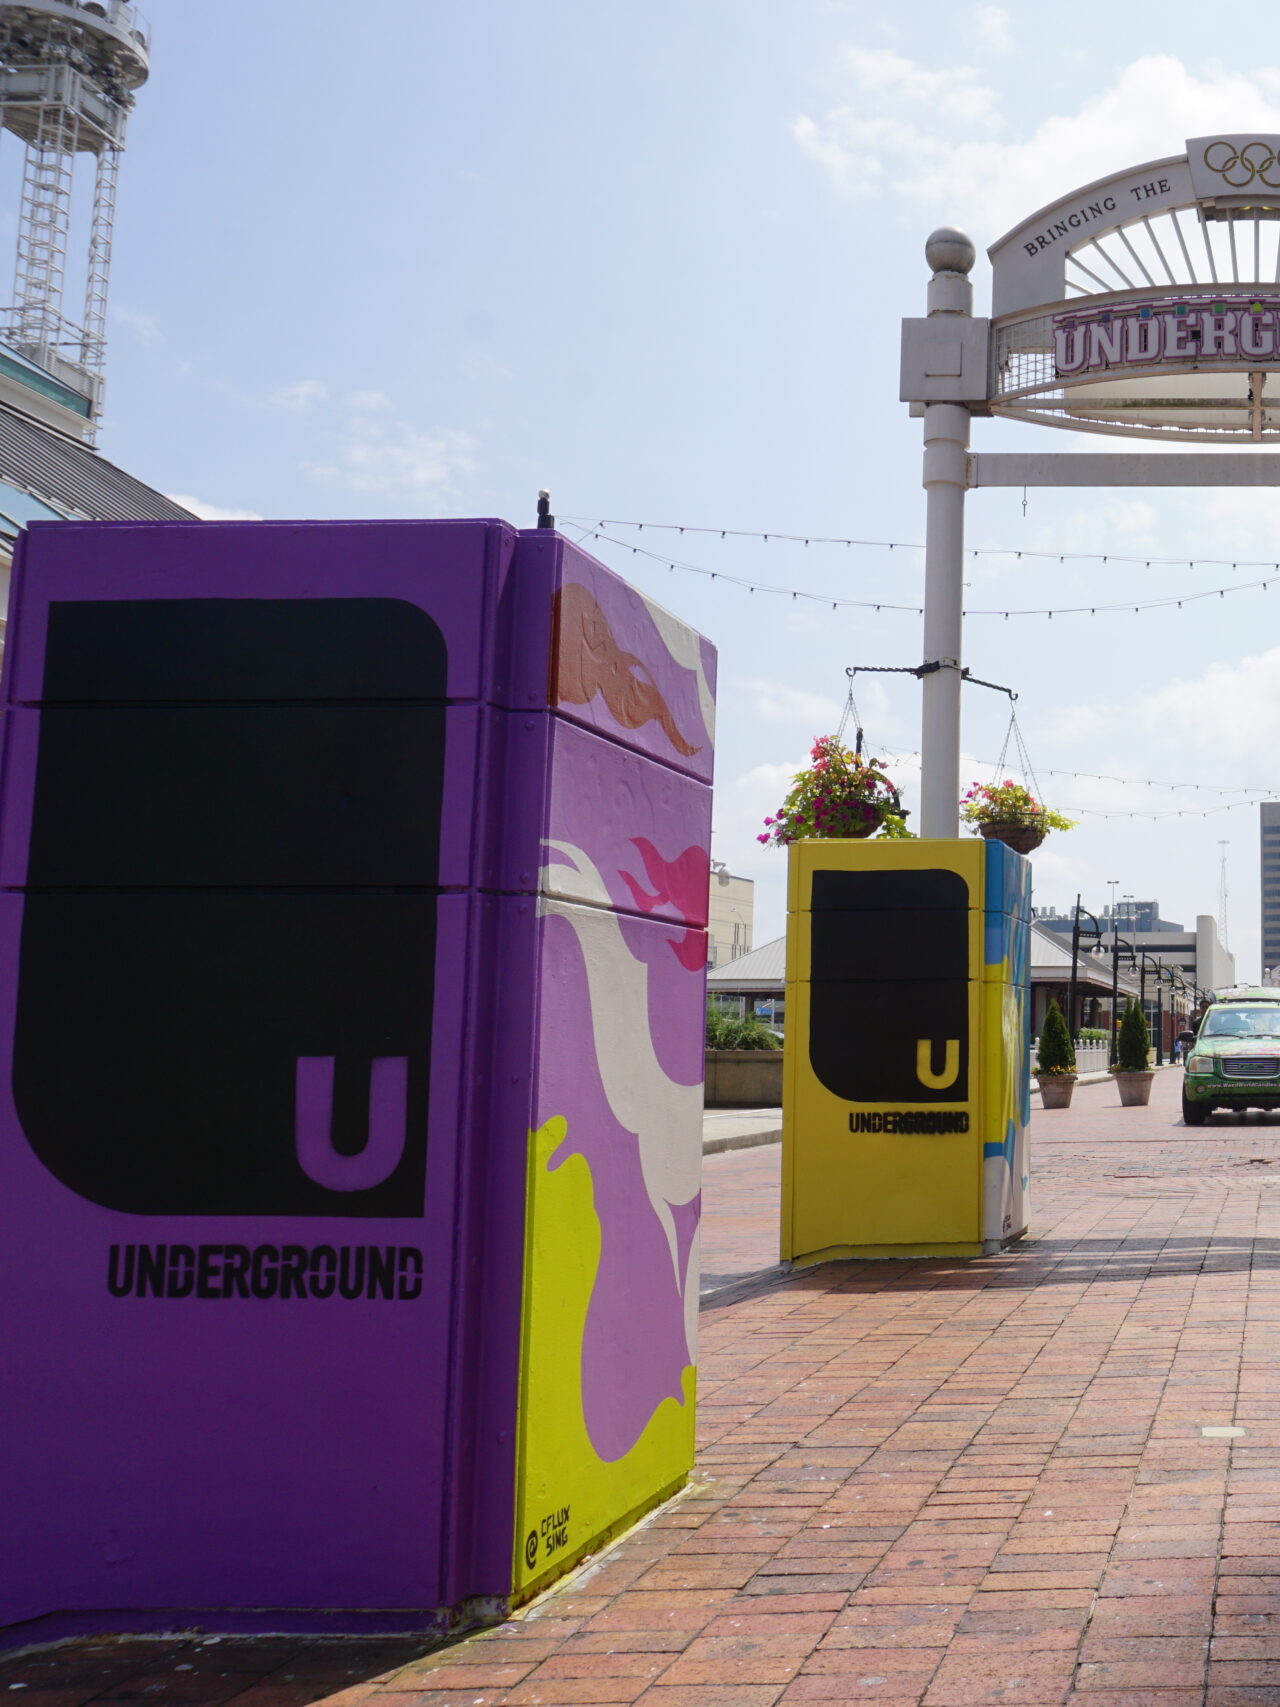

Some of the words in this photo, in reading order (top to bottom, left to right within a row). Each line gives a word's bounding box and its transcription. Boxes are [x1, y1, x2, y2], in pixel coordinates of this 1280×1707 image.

[1024, 197, 1116, 257] BRINGING
[1130, 179, 1170, 201] THE
[916, 1039, 960, 1090] U
[295, 1056, 408, 1192] U
[849, 1111, 969, 1135] UNDERGROUND
[107, 1243, 423, 1301] UNDERGROUND
